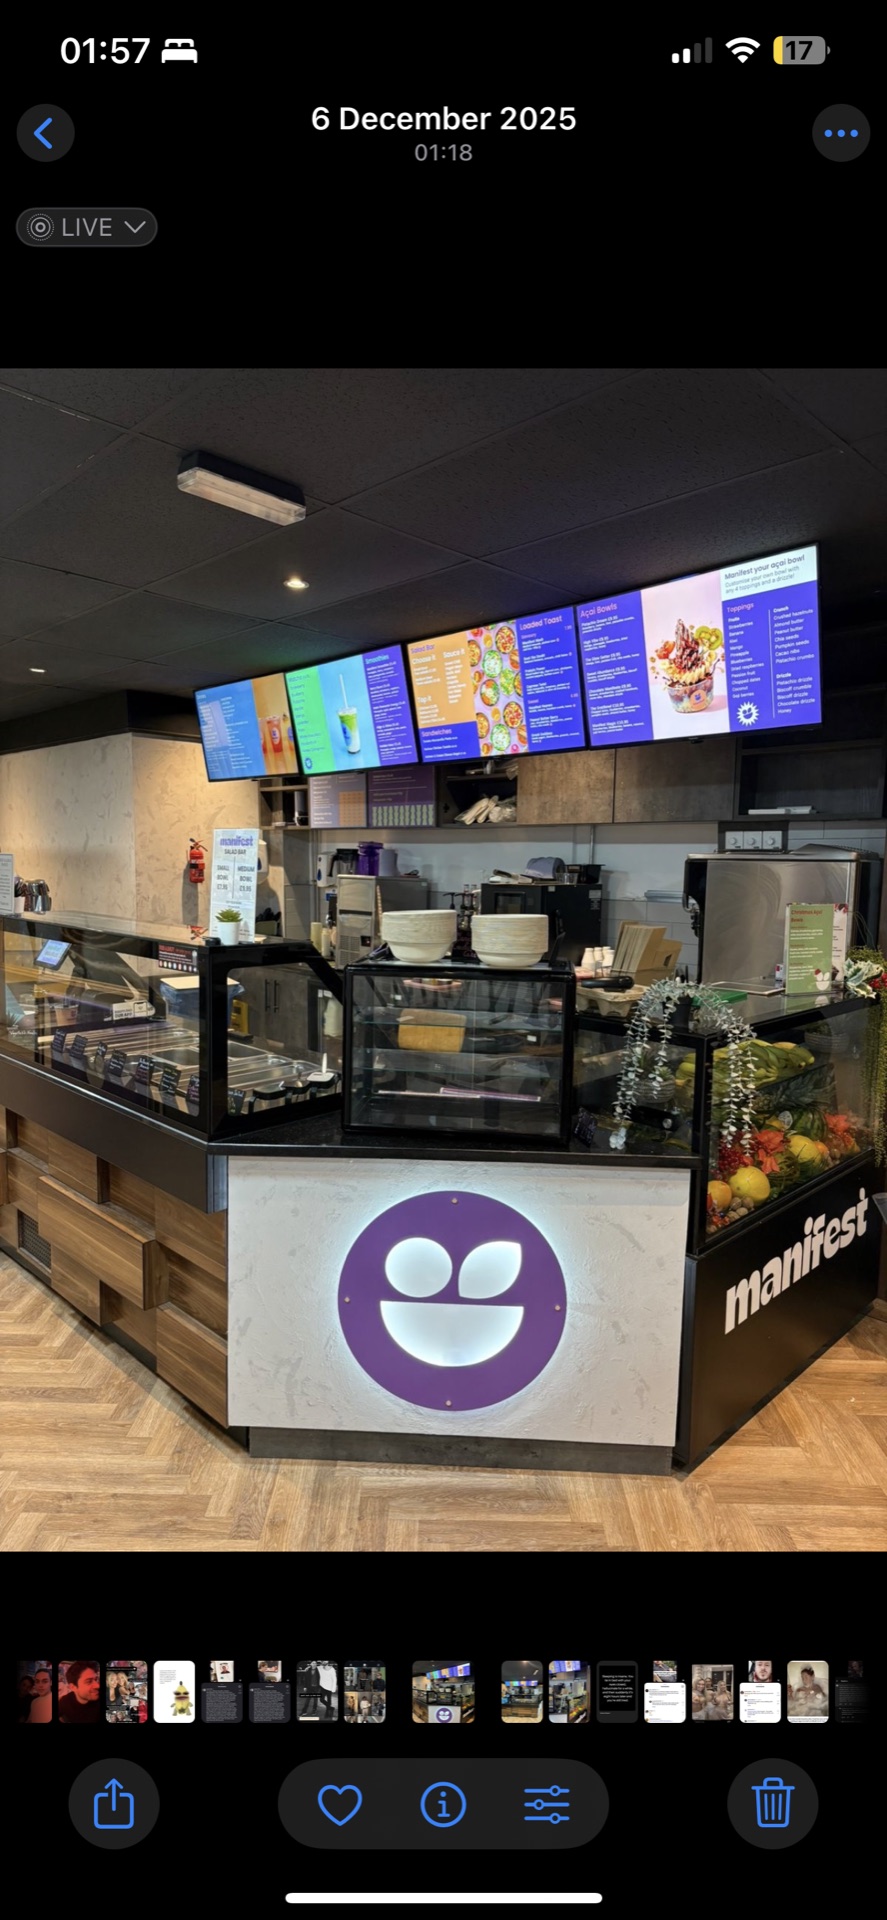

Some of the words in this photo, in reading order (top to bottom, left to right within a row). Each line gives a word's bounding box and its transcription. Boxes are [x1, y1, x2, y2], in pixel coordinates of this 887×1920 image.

[725, 568, 753, 580] Manifest
[754, 565, 769, 574] your
[788, 554, 804, 564] bowl
[740, 582, 760, 591] toppings
[597, 603, 617, 614] Bowls
[727, 603, 754, 613] Toppings
[520, 619, 543, 630] Loaded
[544, 615, 562, 625] Toast
[422, 729, 452, 737] Sandwiches
[220, 835, 253, 846] manifest
[725, 1187, 868, 1335] manifest
